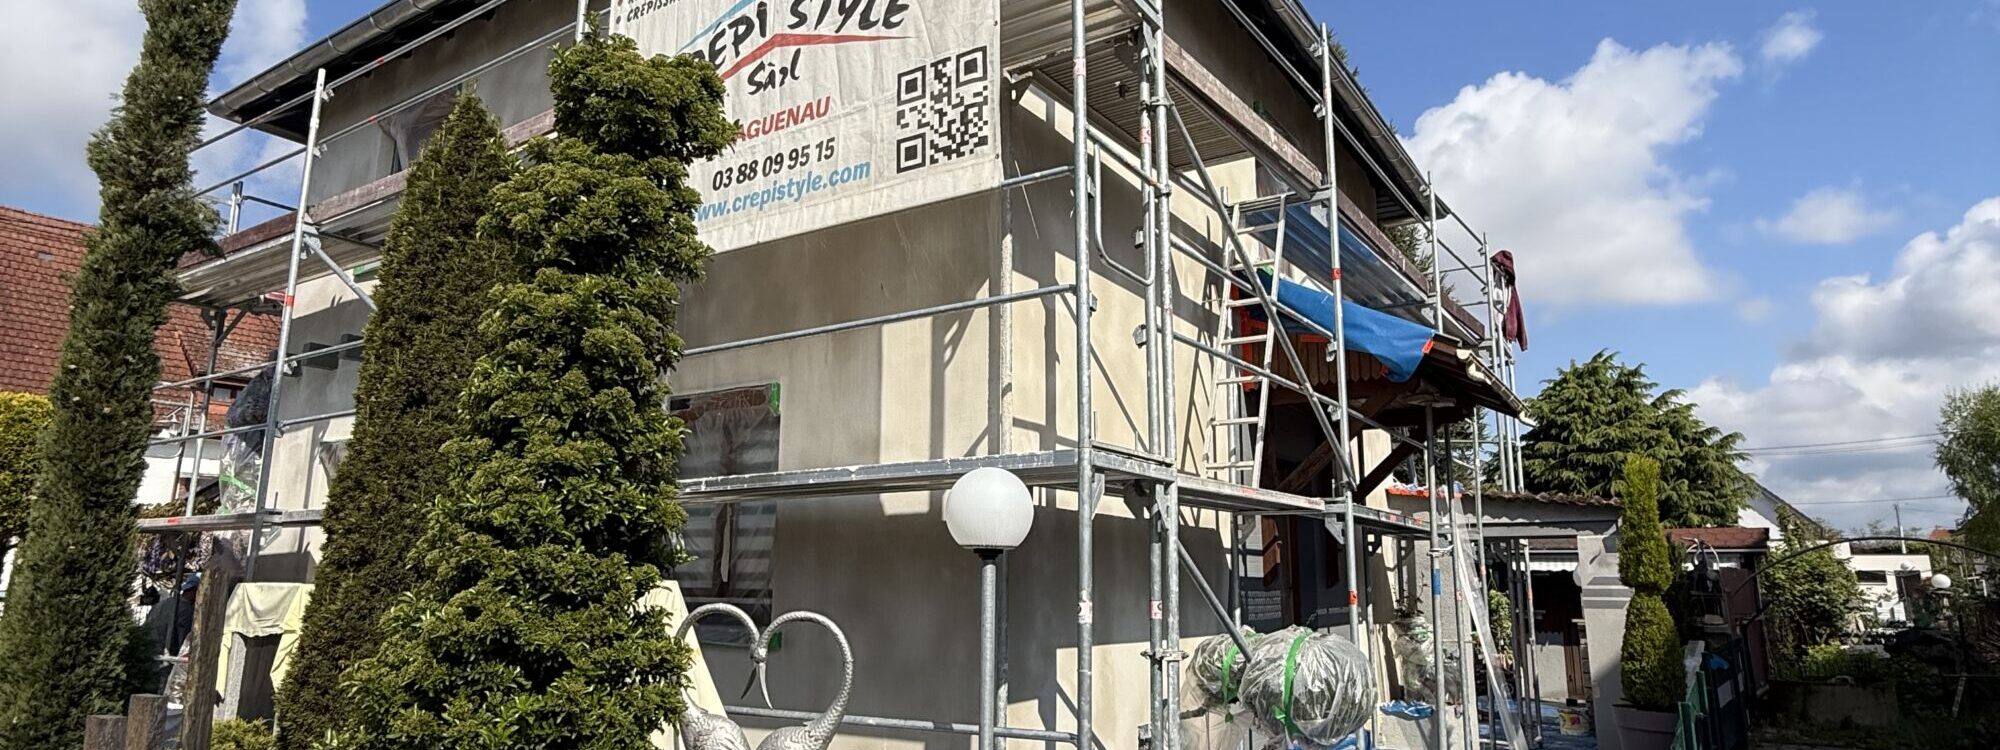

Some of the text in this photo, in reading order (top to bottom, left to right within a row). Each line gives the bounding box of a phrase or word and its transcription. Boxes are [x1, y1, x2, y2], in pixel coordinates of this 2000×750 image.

[627, 0, 682, 22] CREPISS
[692, 1, 768, 70] ÉPI
[735, 96, 831, 142] AGUENAU
[712, 137, 836, 191] 03 88 09 95 15
[696, 161, 872, 222] ww.crepistyle.com
